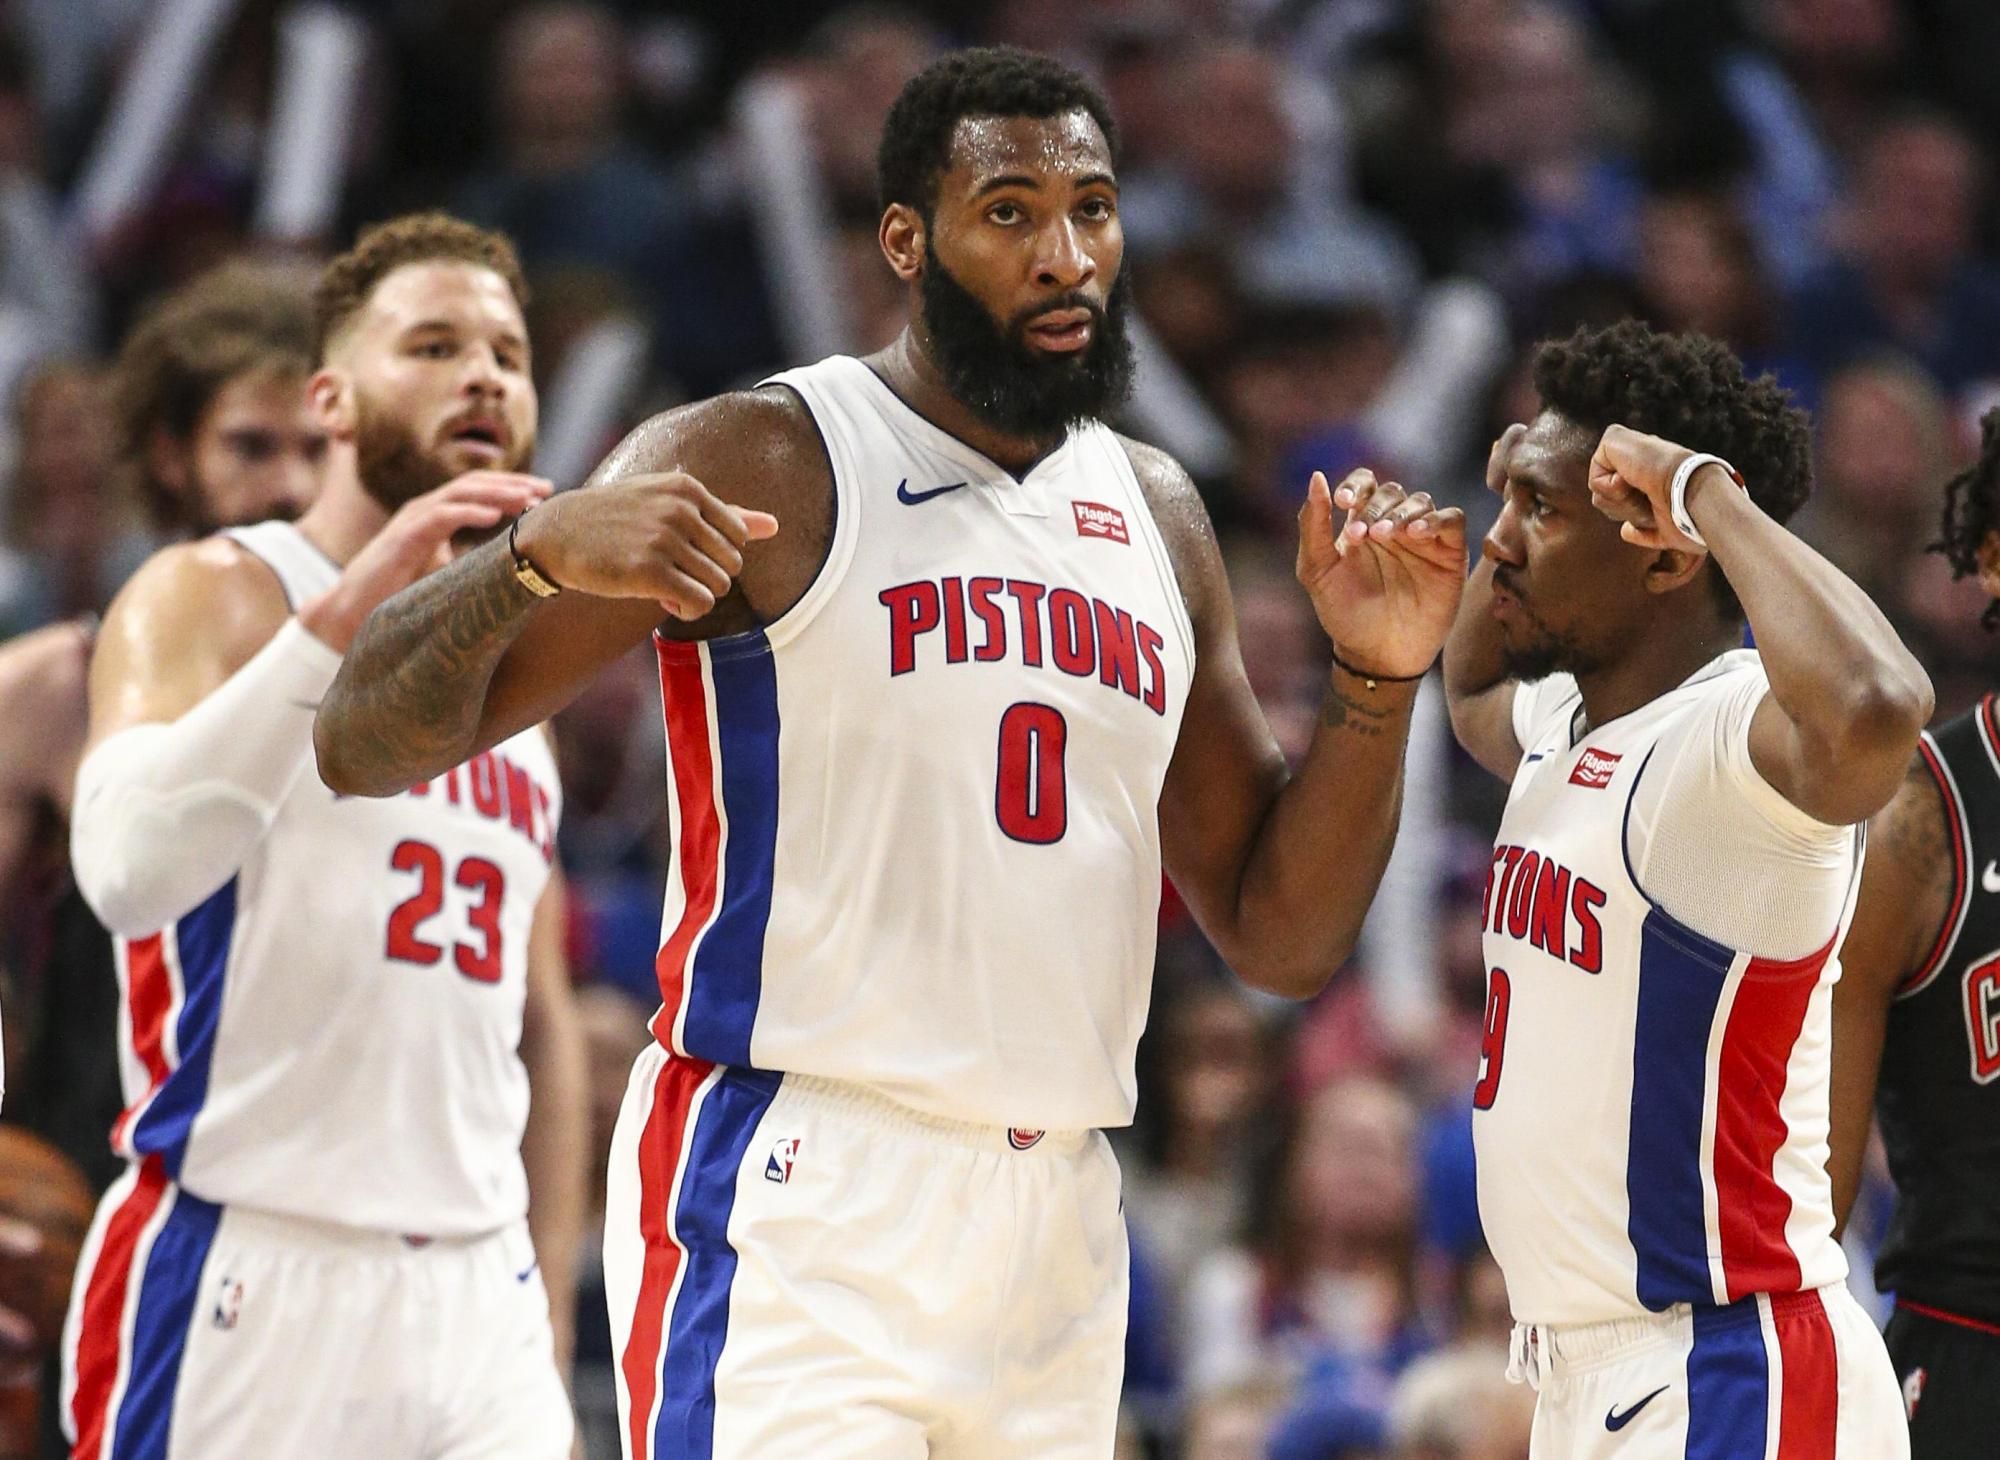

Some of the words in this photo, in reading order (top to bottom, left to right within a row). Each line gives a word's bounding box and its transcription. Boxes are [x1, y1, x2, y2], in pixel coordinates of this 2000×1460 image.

[878, 576, 1166, 716] PISTONS
[995, 701, 1068, 845] 0
[384, 838, 506, 986] 23
